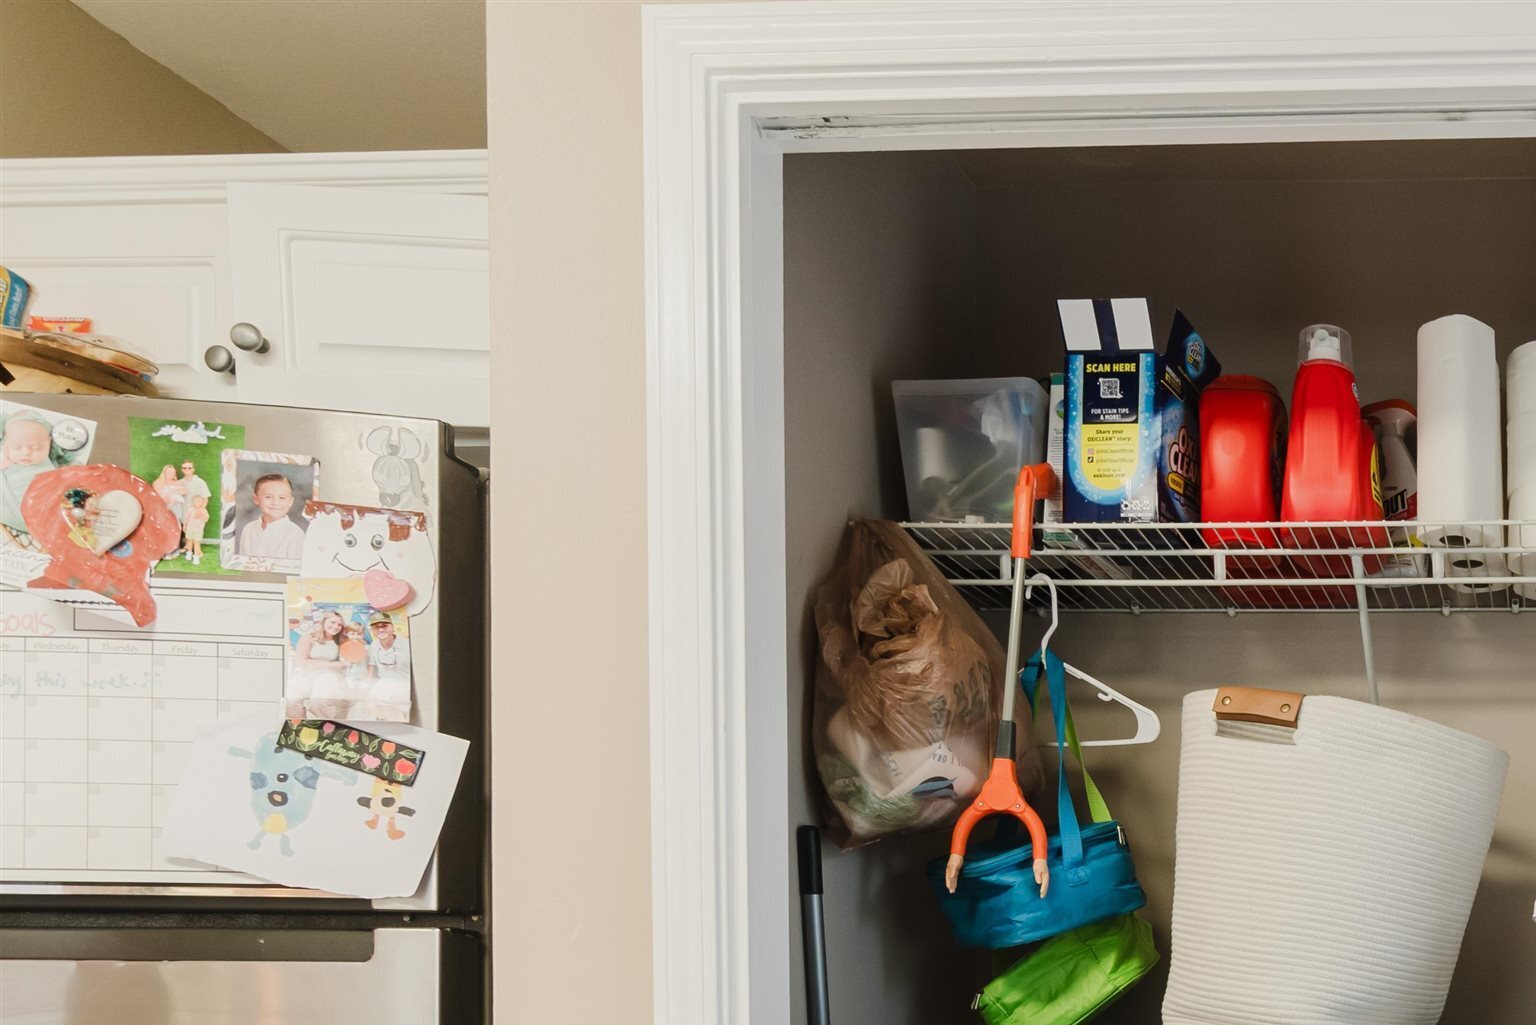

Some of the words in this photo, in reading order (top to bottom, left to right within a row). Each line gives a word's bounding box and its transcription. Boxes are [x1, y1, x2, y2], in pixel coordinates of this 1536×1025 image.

[1086, 363, 1111, 373] SCAN
[1112, 363, 1136, 372] HERE
[172, 645, 199, 656] Friday
[231, 648, 270, 659] Saturday
